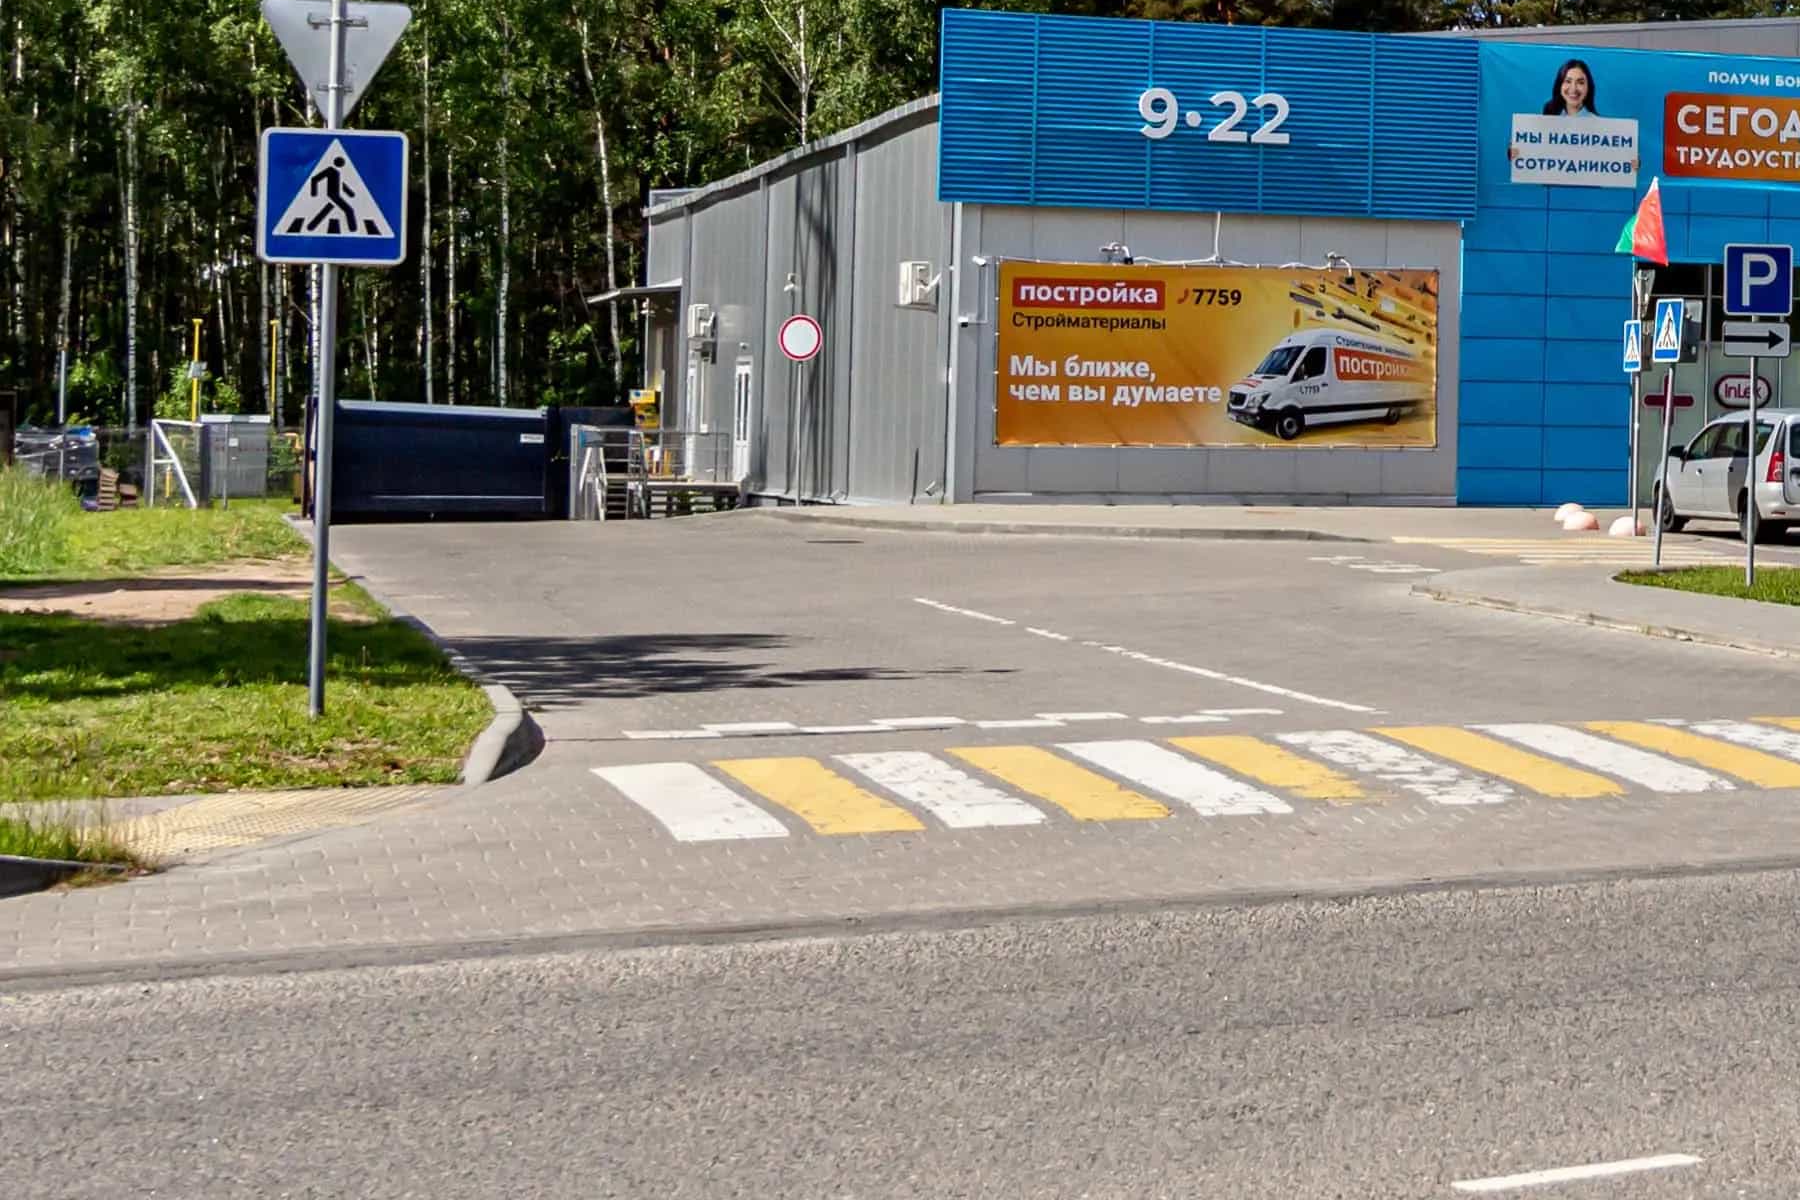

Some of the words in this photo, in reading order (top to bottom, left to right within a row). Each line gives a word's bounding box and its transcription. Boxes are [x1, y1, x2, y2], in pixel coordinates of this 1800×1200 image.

[1708, 71, 1769, 87] ПОЛУЧИ
[1515, 131, 1542, 144] МЫ
[1548, 132, 1633, 148] НАБИРАЕМ
[1514, 157, 1632, 174] СОТРУДНИКОВ
[1741, 253, 1778, 307] P
[1019, 282, 1159, 306] постройка
[1192, 288, 1242, 306] 7759
[1012, 311, 1167, 332] Стройматериалы
[1009, 355, 1057, 377] Мы
[1064, 354, 1156, 382] ближе,
[1009, 383, 1060, 402] чем
[1068, 384, 1106, 402] вы
[1112, 385, 1224, 407] думаете
